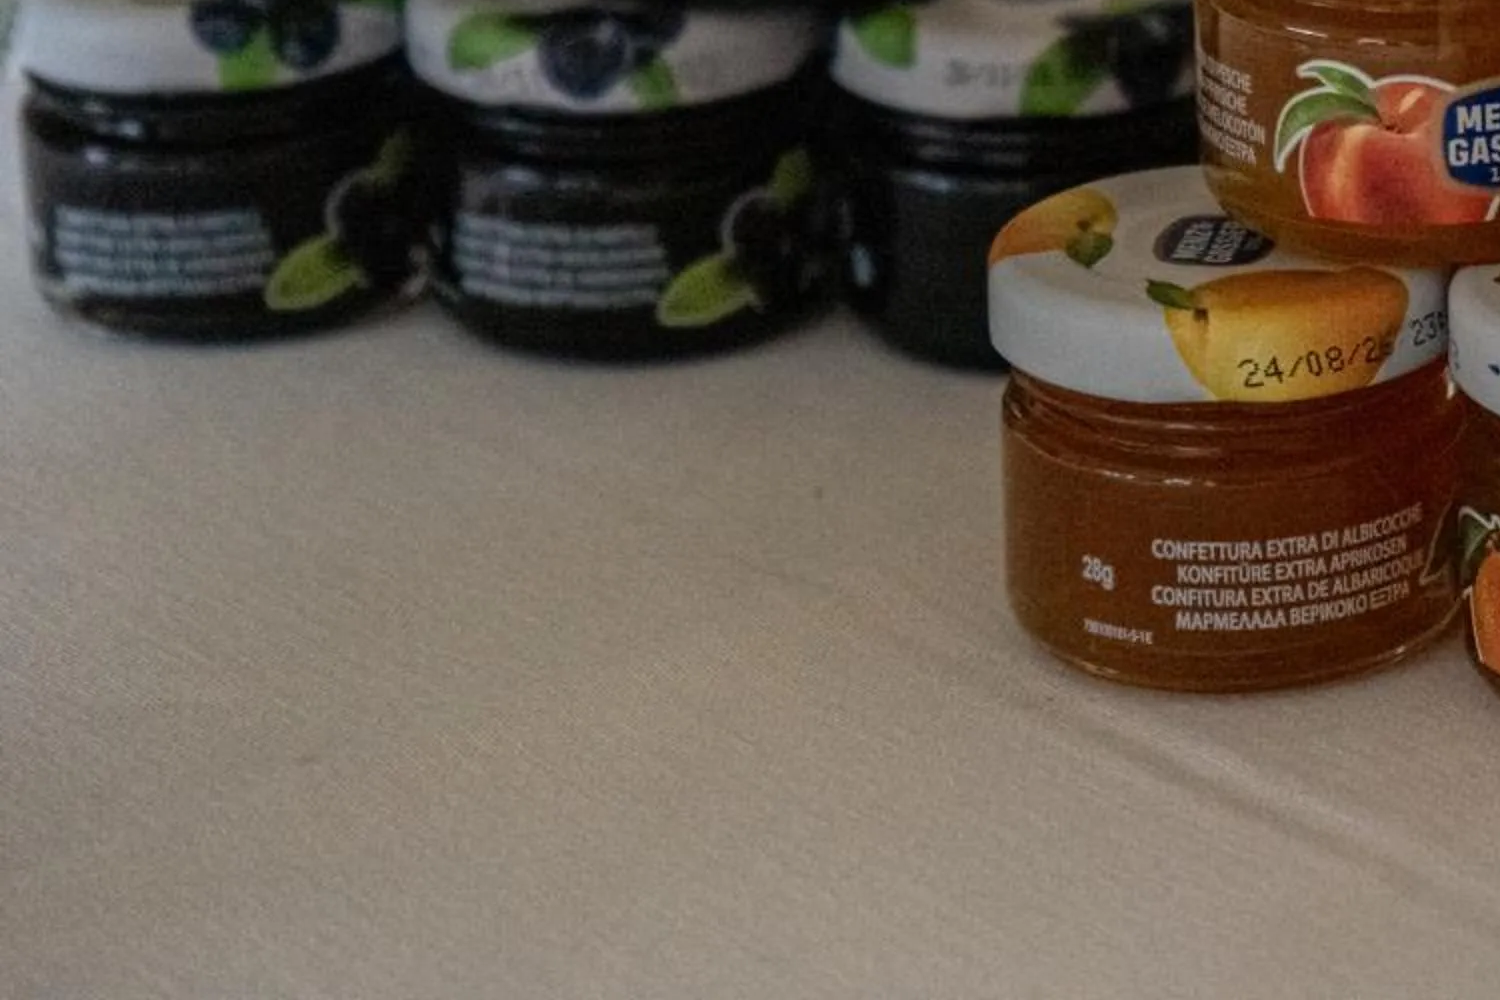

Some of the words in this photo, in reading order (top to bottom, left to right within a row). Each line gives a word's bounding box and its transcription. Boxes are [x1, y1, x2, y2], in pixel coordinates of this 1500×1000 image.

[1151, 538, 1263, 561] CONFETTURA
[1266, 534, 1319, 560] EXTRA
[1321, 529, 1339, 551] DI
[1081, 554, 1114, 591] 28g
[1177, 561, 1272, 584] KONFITÜRE
[1275, 556, 1328, 582] EXTRA
[1151, 584, 1248, 607] CONFITURA
[1251, 582, 1305, 606] EXTRA
[1307, 579, 1329, 600] DE
